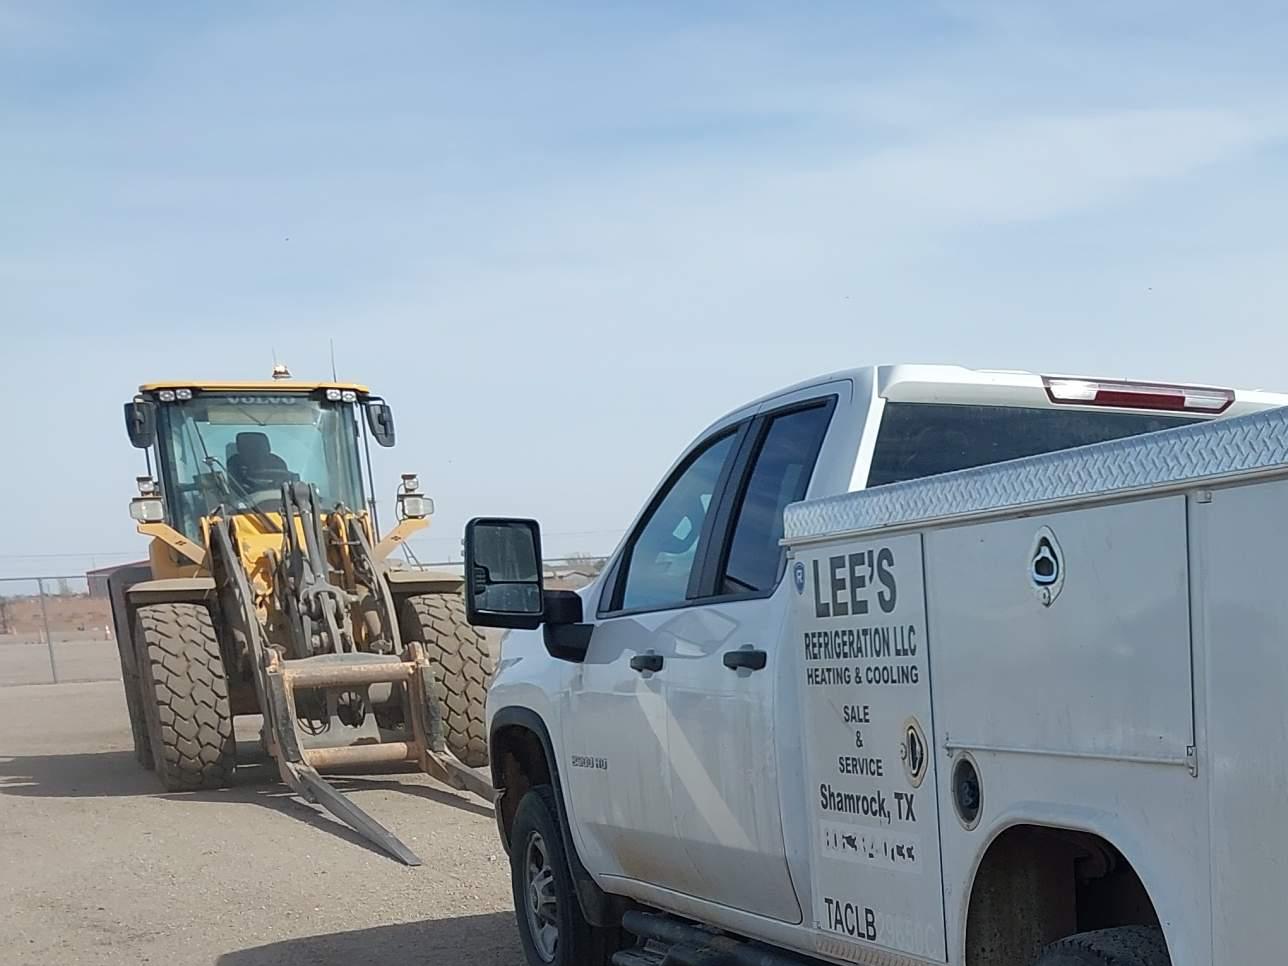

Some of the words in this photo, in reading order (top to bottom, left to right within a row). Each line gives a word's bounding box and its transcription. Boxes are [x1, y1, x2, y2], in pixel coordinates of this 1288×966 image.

[813, 547, 897, 618] LEE'S
[804, 627, 890, 660] REFRIGERATION
[894, 625, 917, 656] LLC
[807, 667, 851, 685] HEATING
[855, 667, 862, 684] &
[866, 665, 919, 684] COOLING
[843, 705, 870, 723] SALE
[856, 730, 863, 748] &
[838, 756, 883, 776] SERVICE
[820, 783, 891, 824] Shamrock,
[894, 792, 916, 822] TX
[824, 897, 877, 941] TACLB
